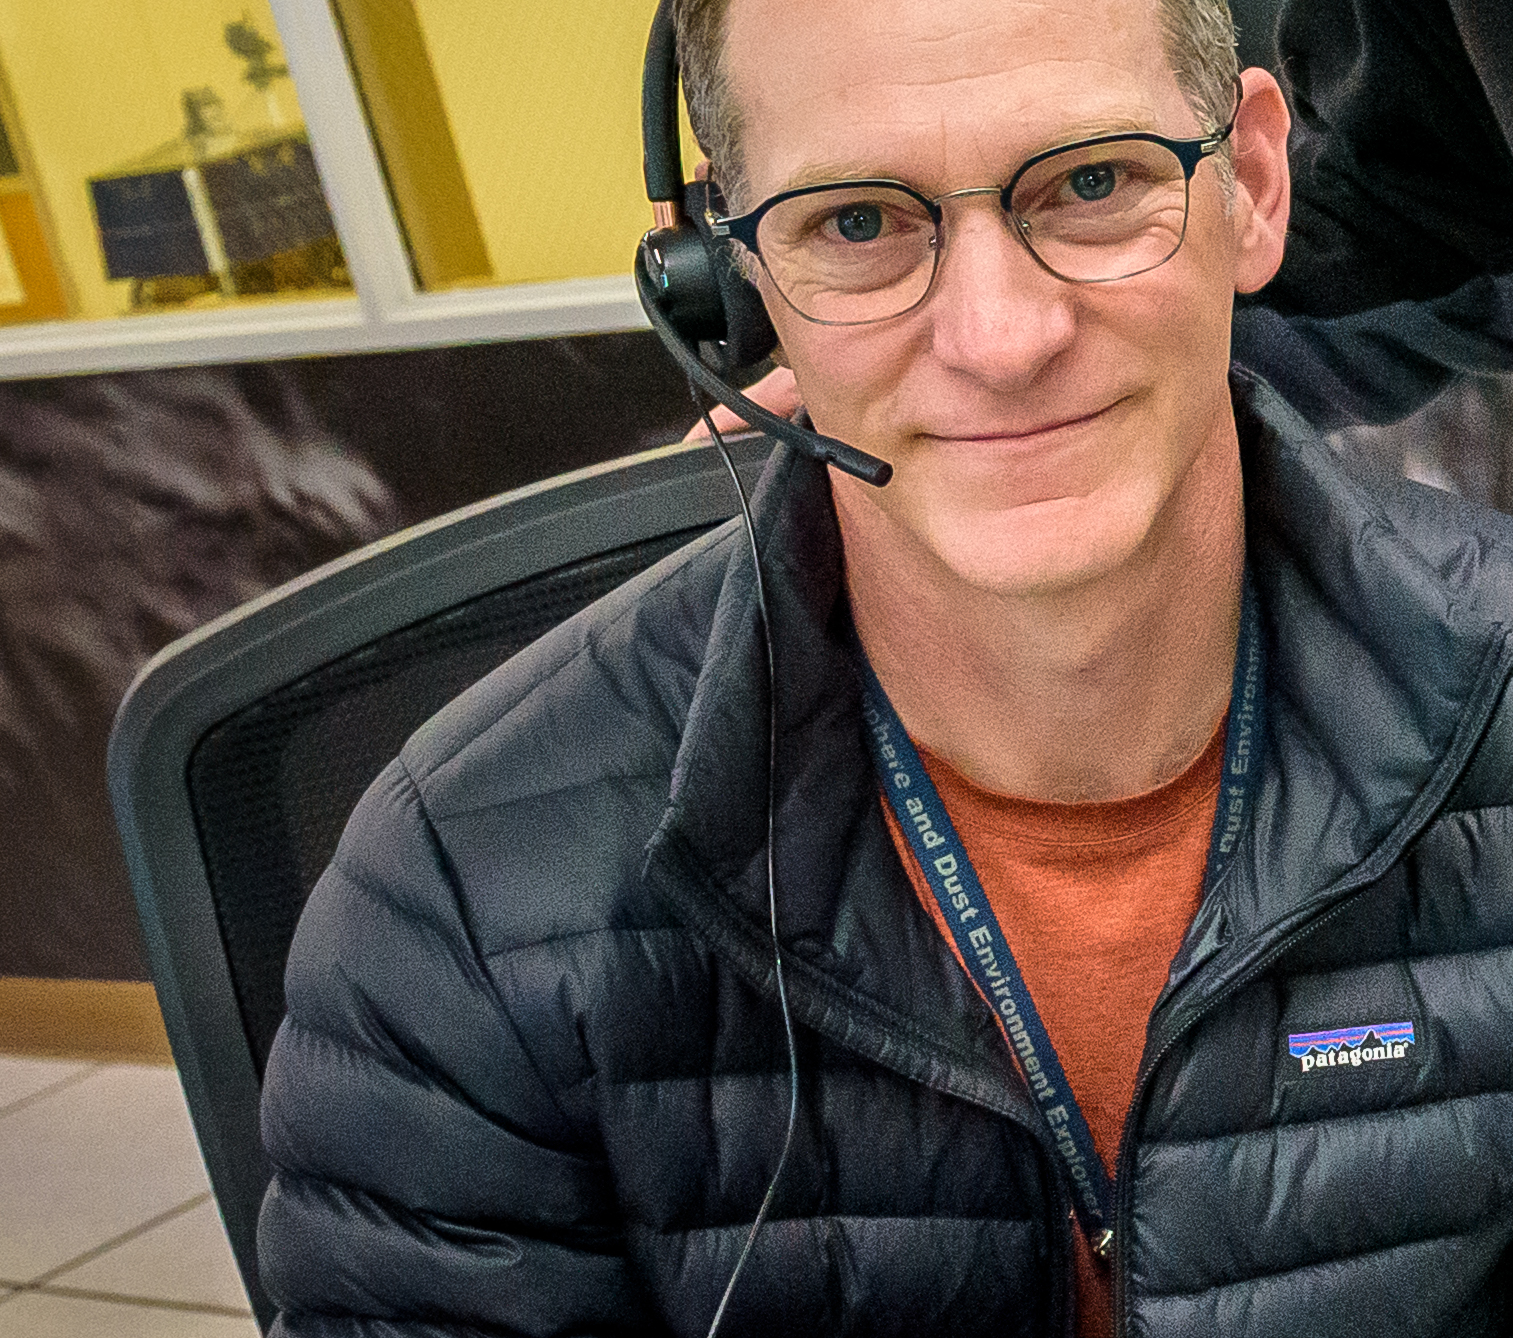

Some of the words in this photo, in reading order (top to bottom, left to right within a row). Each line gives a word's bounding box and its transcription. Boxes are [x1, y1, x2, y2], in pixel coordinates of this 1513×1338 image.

[906, 797, 945, 849] and
[933, 853, 979, 923] Dust
[968, 915, 1056, 1102] Environment
[1301, 1042, 1407, 1072] patagonia
